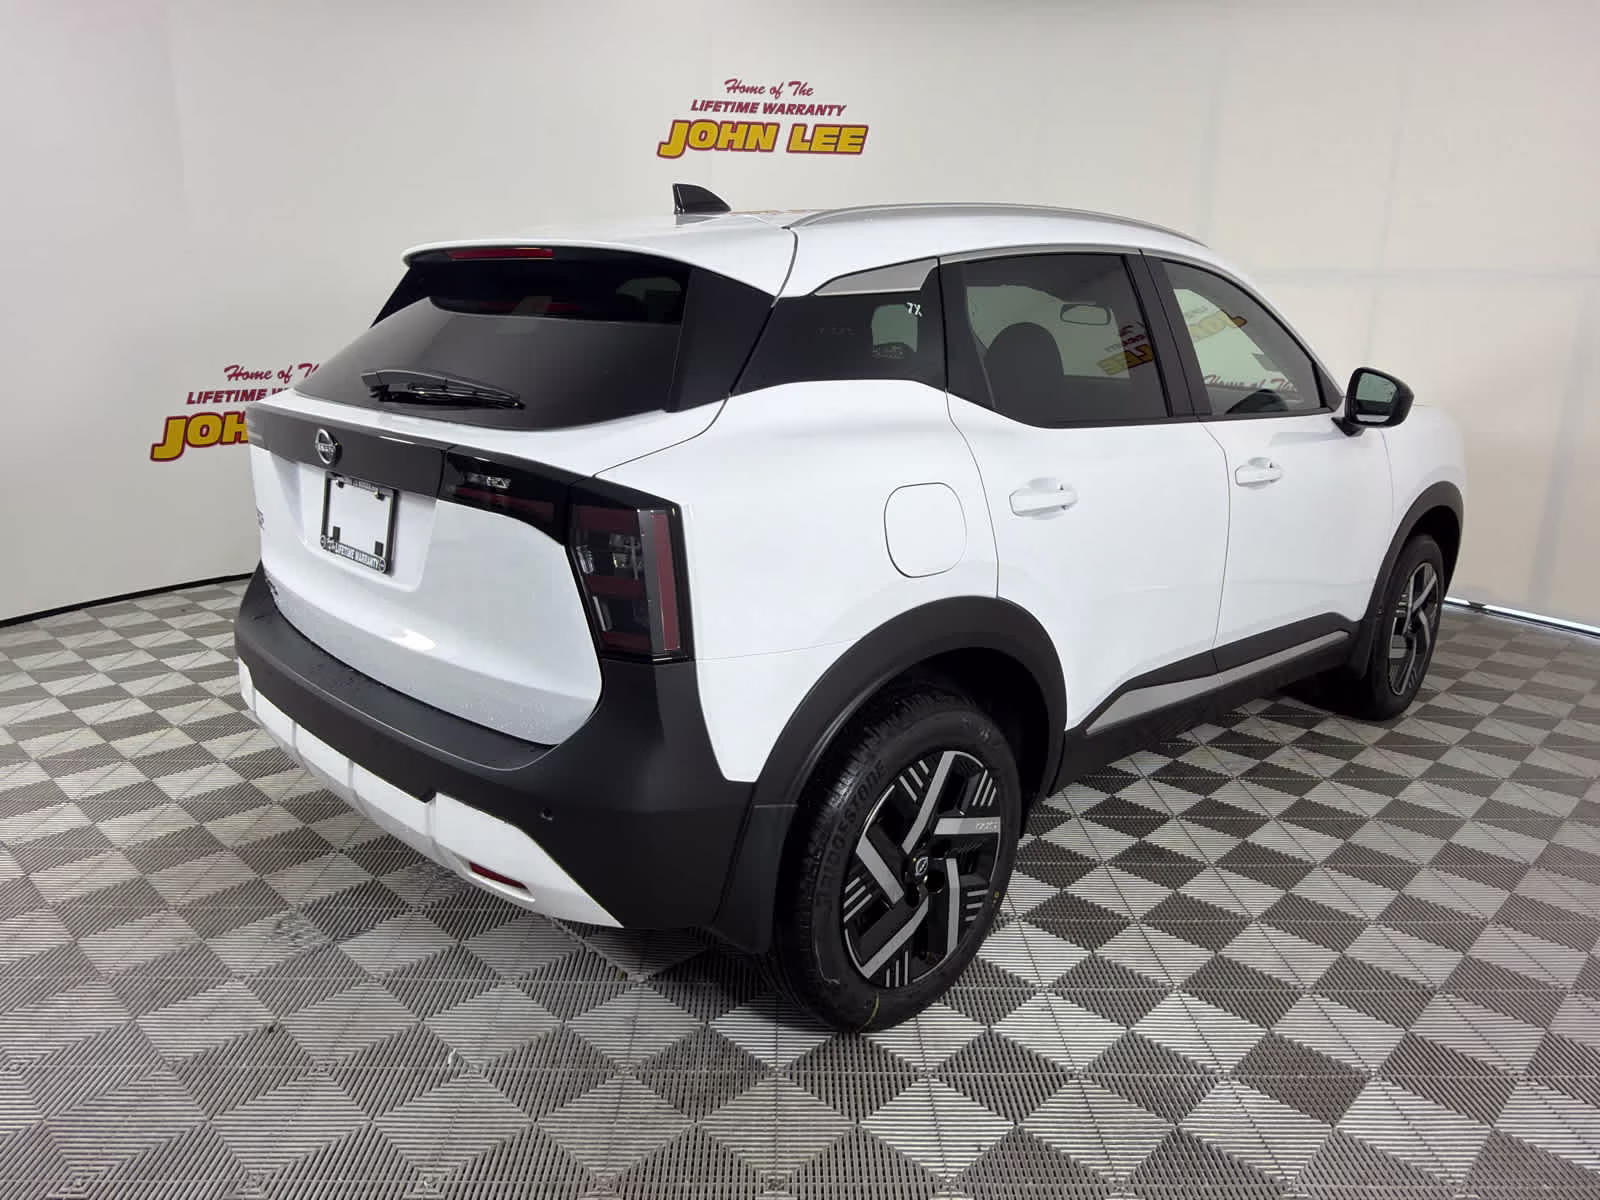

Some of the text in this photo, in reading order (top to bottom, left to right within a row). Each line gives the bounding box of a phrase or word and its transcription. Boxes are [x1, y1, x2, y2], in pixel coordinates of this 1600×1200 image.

[724, 78, 814, 99] Home of The
[690, 99, 847, 117] LIFETIME WARRANTY
[657, 119, 869, 159] JOHN LEE
[224, 364, 273, 381] Home
[276, 365, 293, 383] of
[186, 387, 268, 405] LIFETIME
[150, 411, 248, 462] JOH
